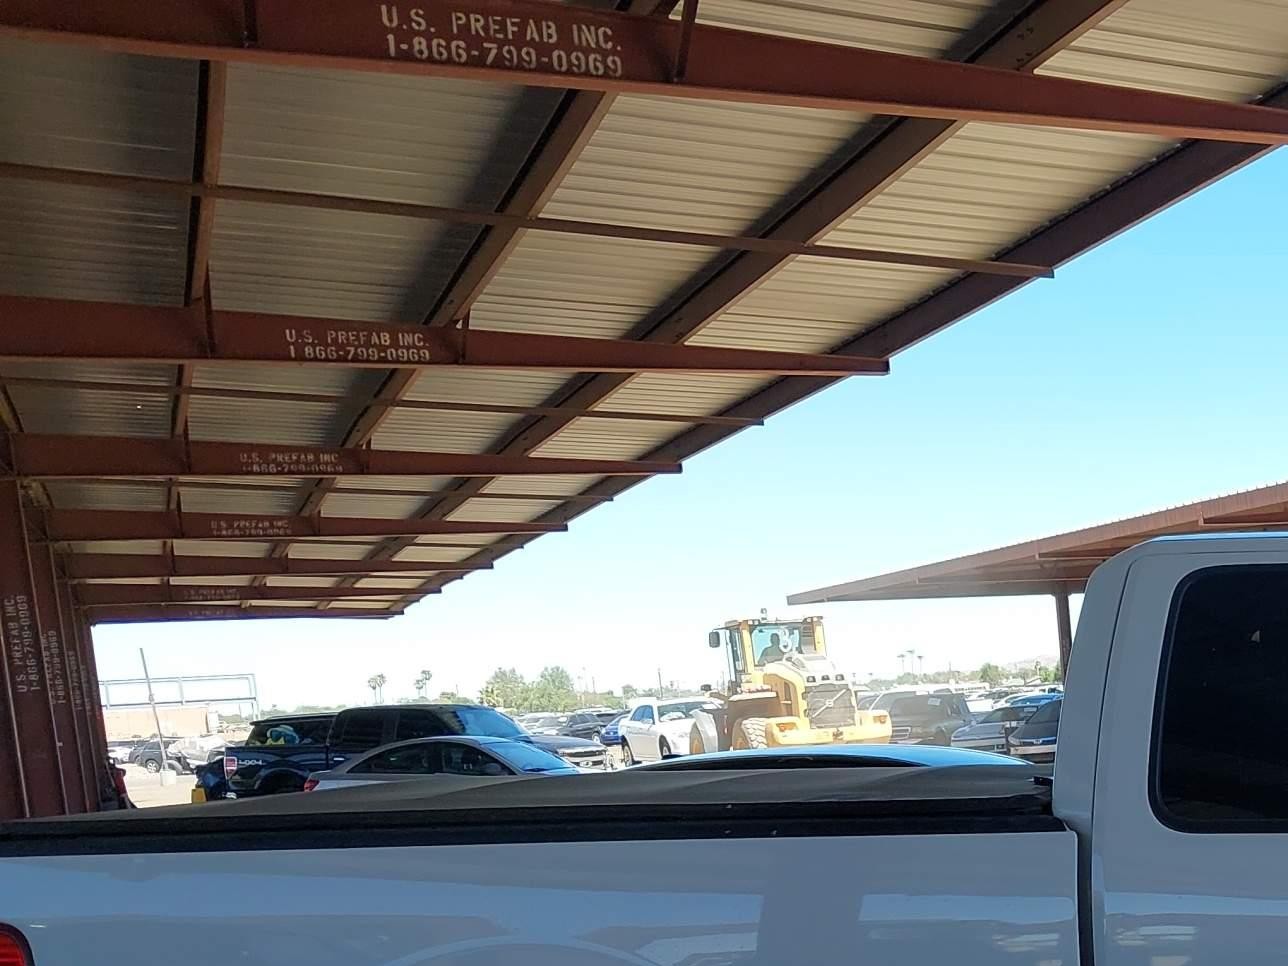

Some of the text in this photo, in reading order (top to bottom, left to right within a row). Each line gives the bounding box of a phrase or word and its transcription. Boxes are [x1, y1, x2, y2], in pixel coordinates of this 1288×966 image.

[381, 4, 622, 50] U.S. PREFAB INC.
[386, 34, 623, 77] 1-866-799-0969
[285, 329, 430, 347] U.S. PREFAB INC.
[7, 622, 24, 665] PREFAB
